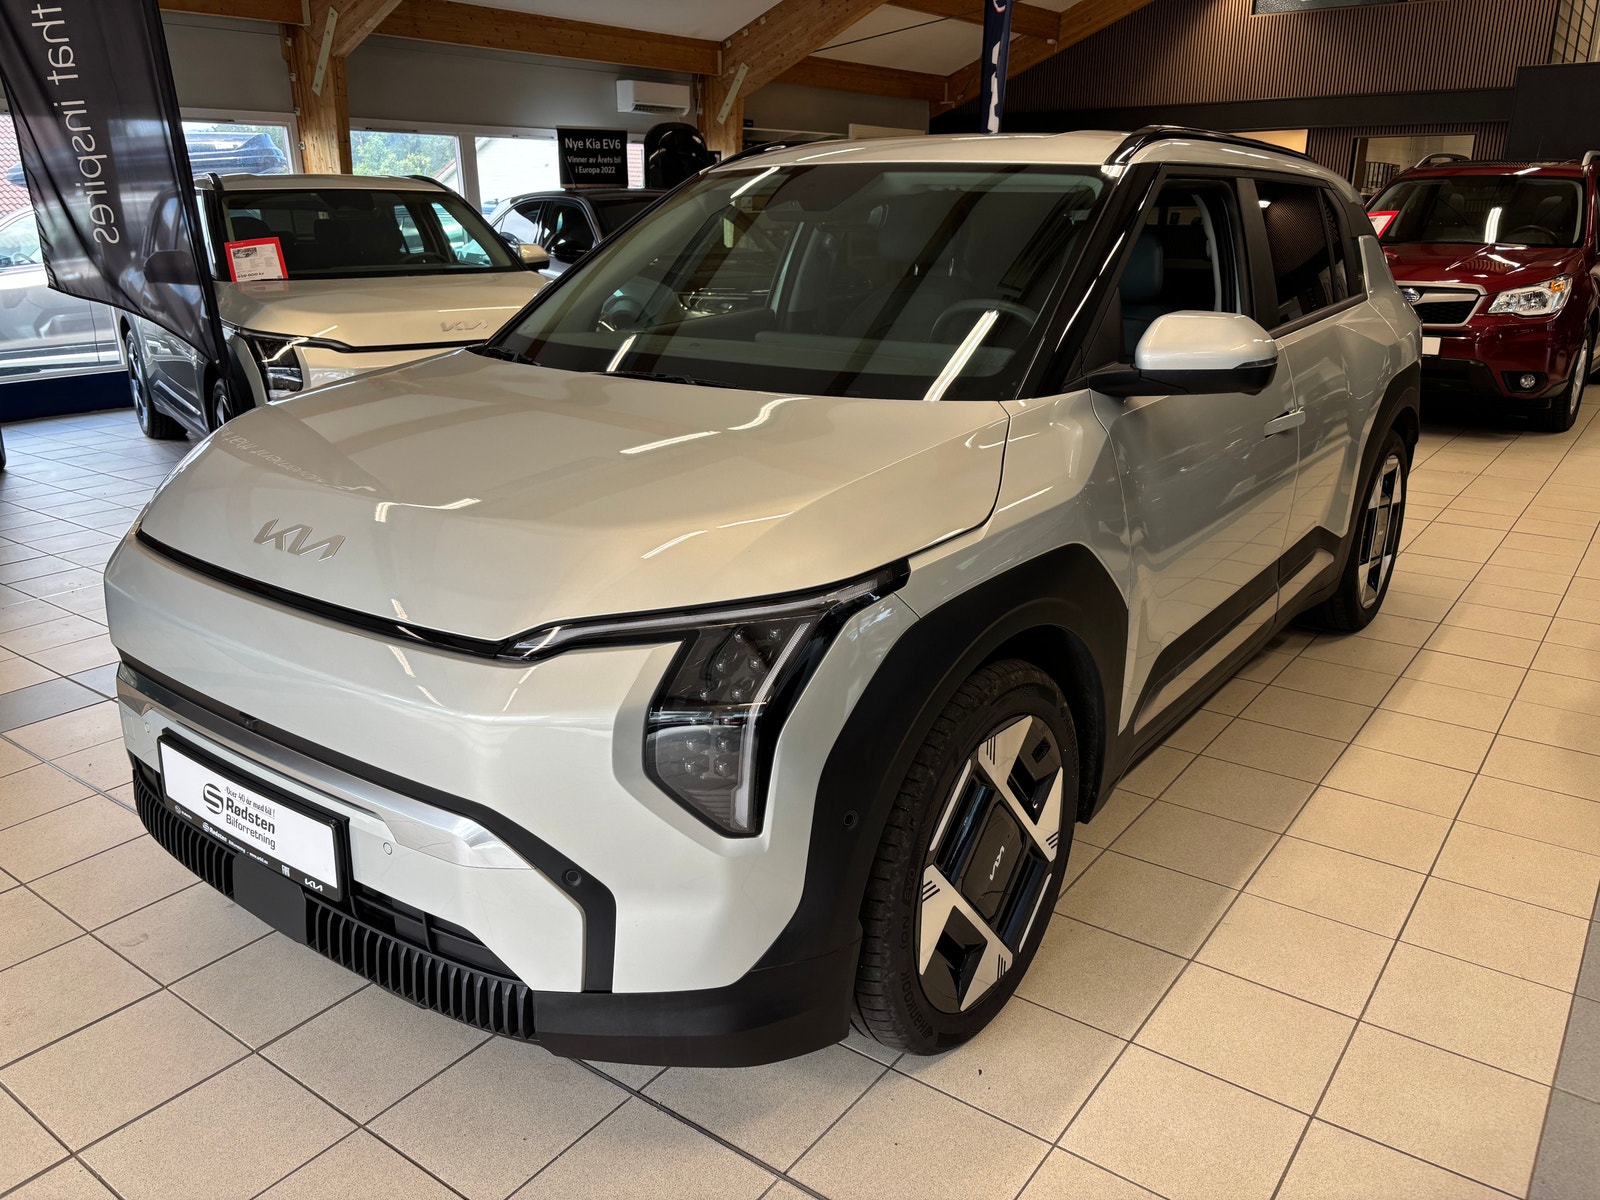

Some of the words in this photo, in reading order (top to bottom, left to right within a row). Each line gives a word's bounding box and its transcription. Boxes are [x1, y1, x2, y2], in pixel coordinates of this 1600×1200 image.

[564, 138, 584, 151] Nye
[586, 138, 600, 149] Kia
[602, 139, 621, 149] EV6
[567, 155, 587, 163] Vinner
[598, 155, 613, 163] Årets
[579, 166, 600, 175] Europa
[253, 518, 346, 562] KIA
[226, 797, 275, 834] Rødsten
[226, 814, 276, 850] Bilforretning
[304, 877, 323, 892] KIA
